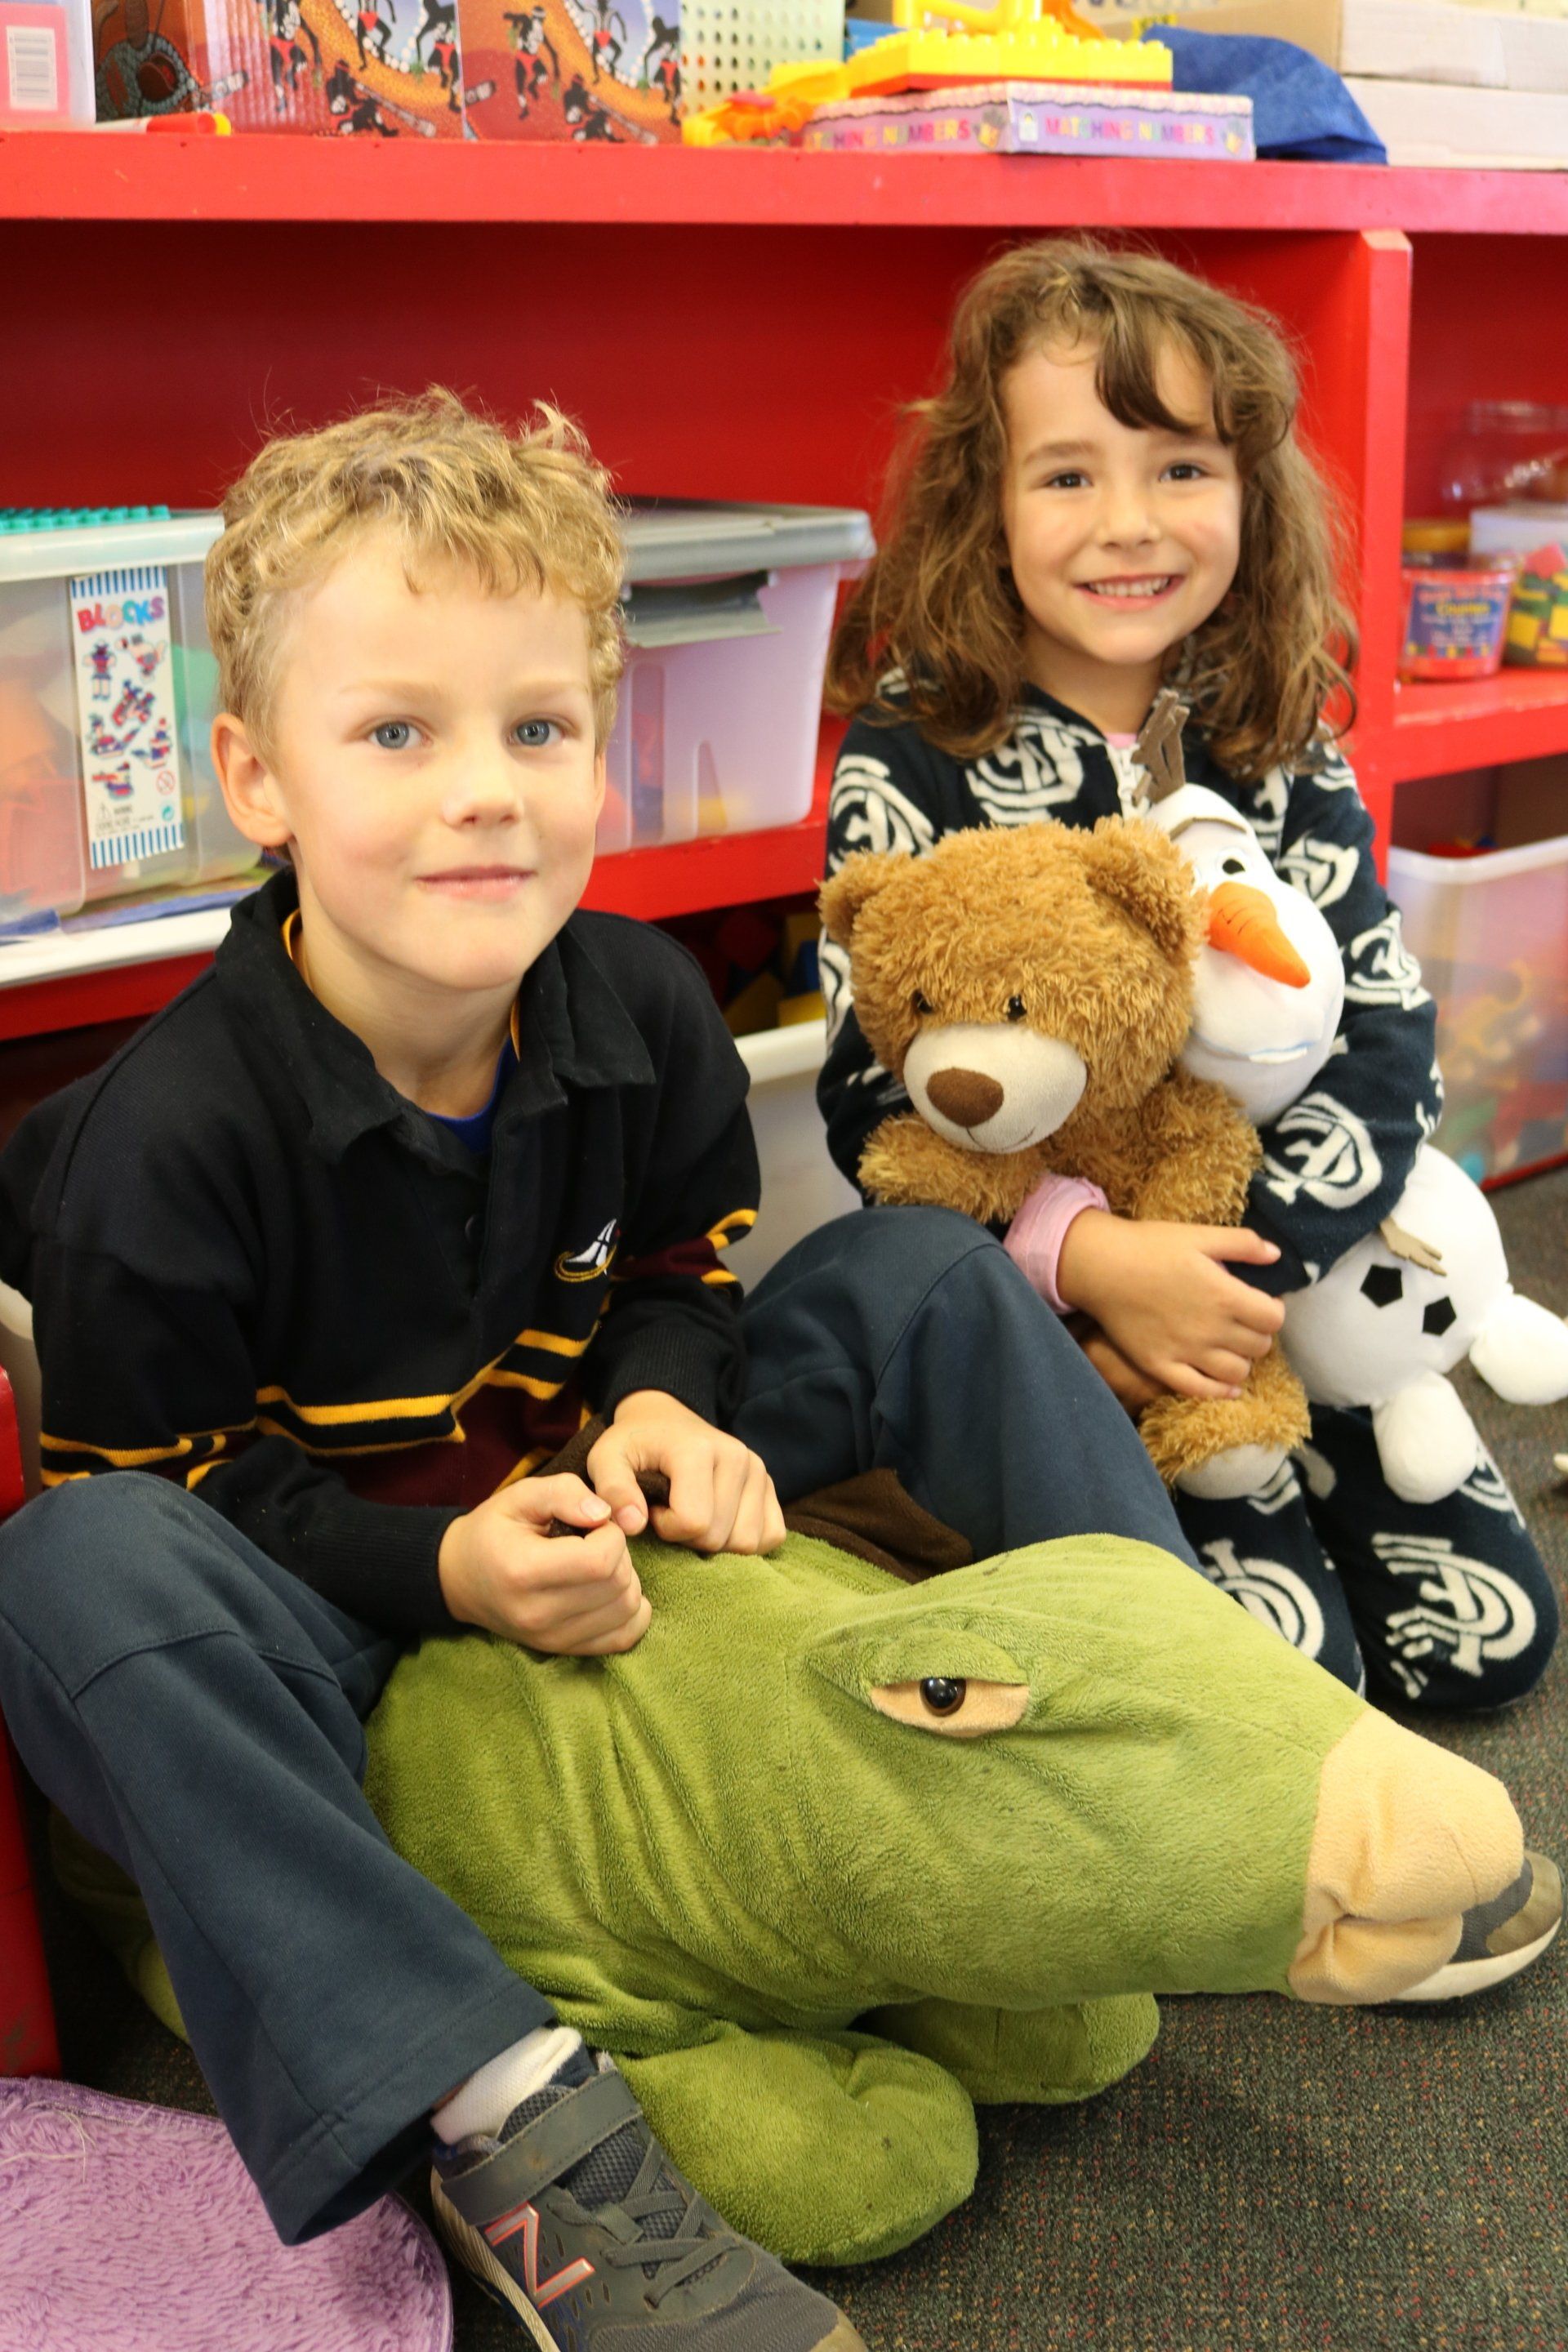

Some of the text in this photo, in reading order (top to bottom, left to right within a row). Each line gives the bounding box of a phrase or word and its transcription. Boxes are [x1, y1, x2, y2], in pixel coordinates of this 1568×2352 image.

[883, 118, 972, 145] NUMBERS
[1045, 117, 1215, 145] MATCHING NUMBERS
[77, 596, 163, 633] BLOCKS
